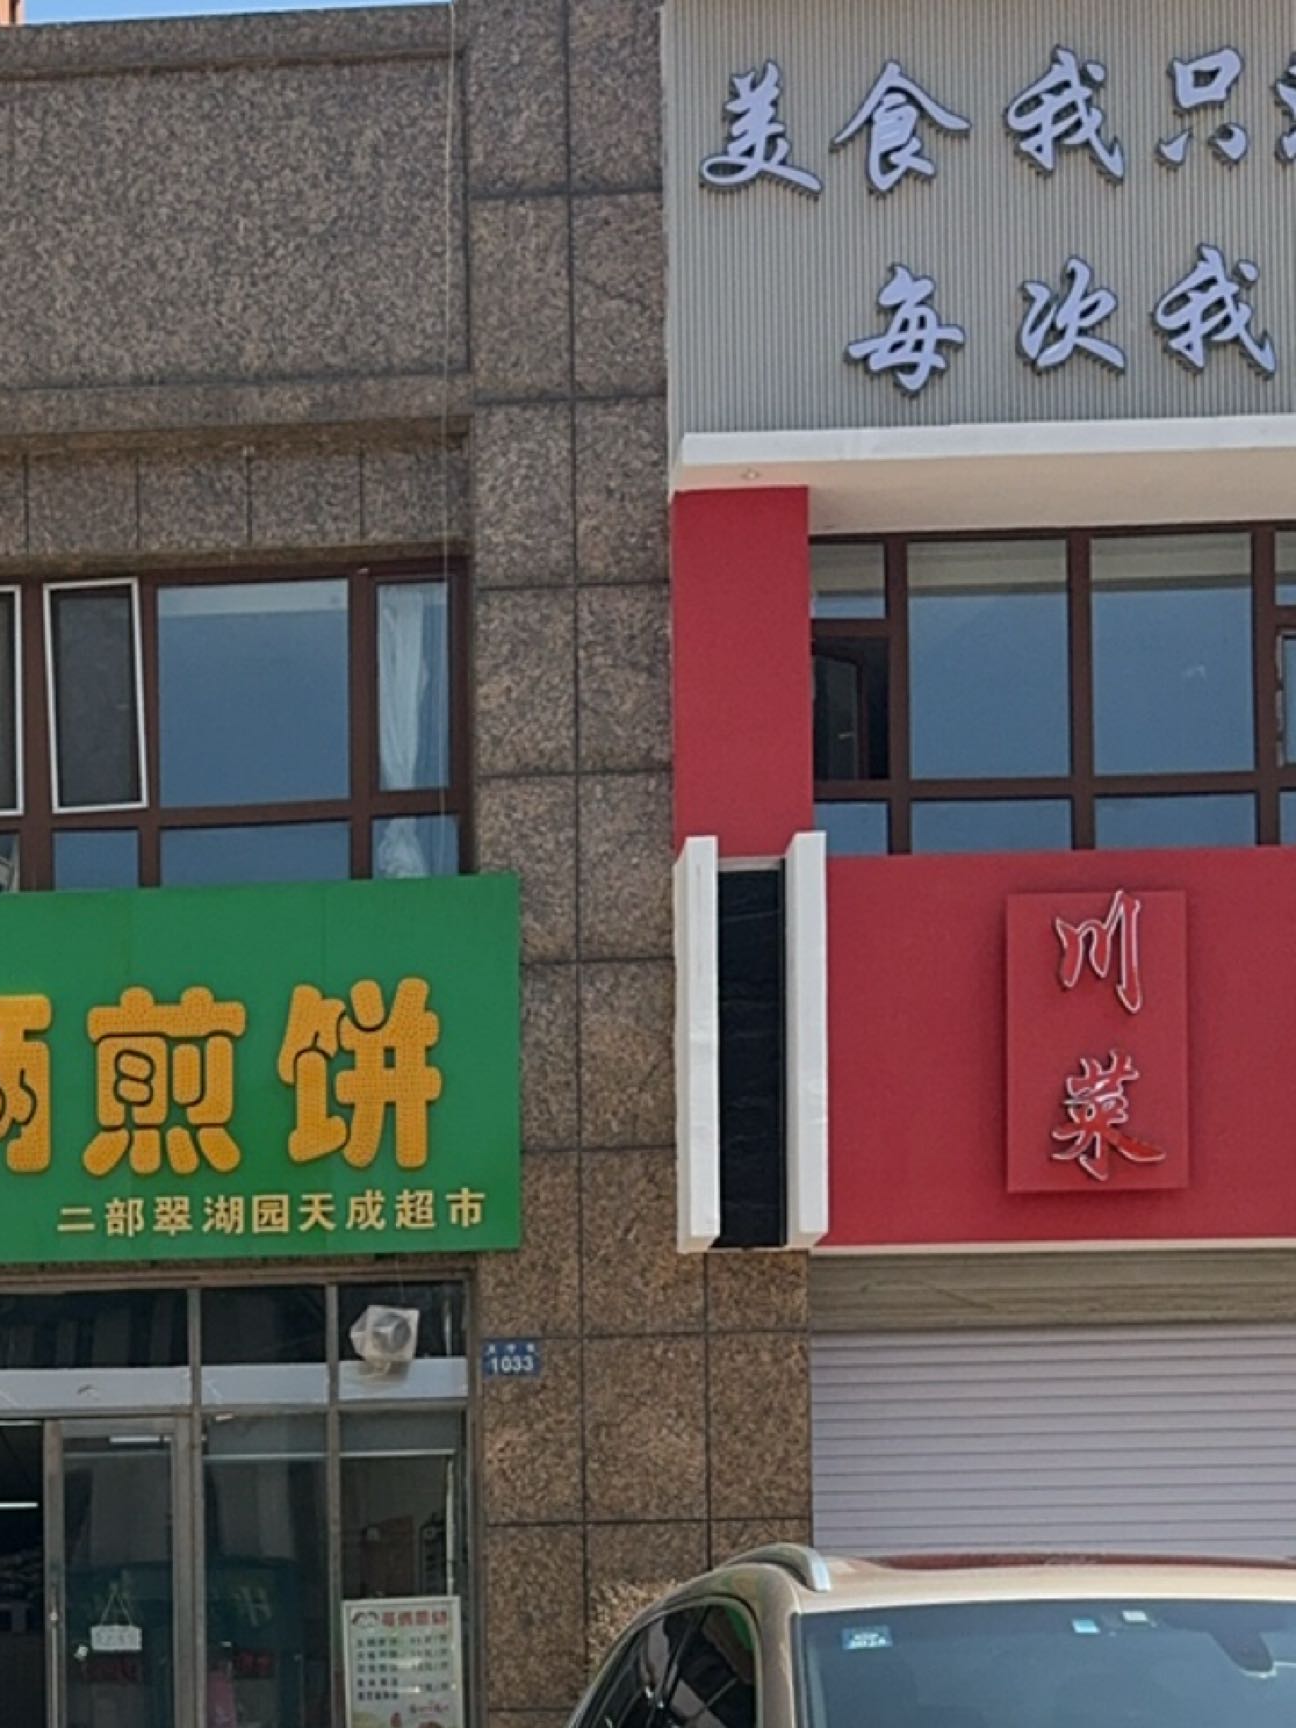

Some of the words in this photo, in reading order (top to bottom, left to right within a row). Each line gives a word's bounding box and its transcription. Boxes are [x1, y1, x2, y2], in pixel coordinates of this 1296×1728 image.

[701, 43, 1296, 196] 美食我只
[1051, 888, 1167, 1181] 川菜
[56, 1187, 487, 1238] 二部翠湖园天成超市
[489, 1356, 534, 1375] 1033
